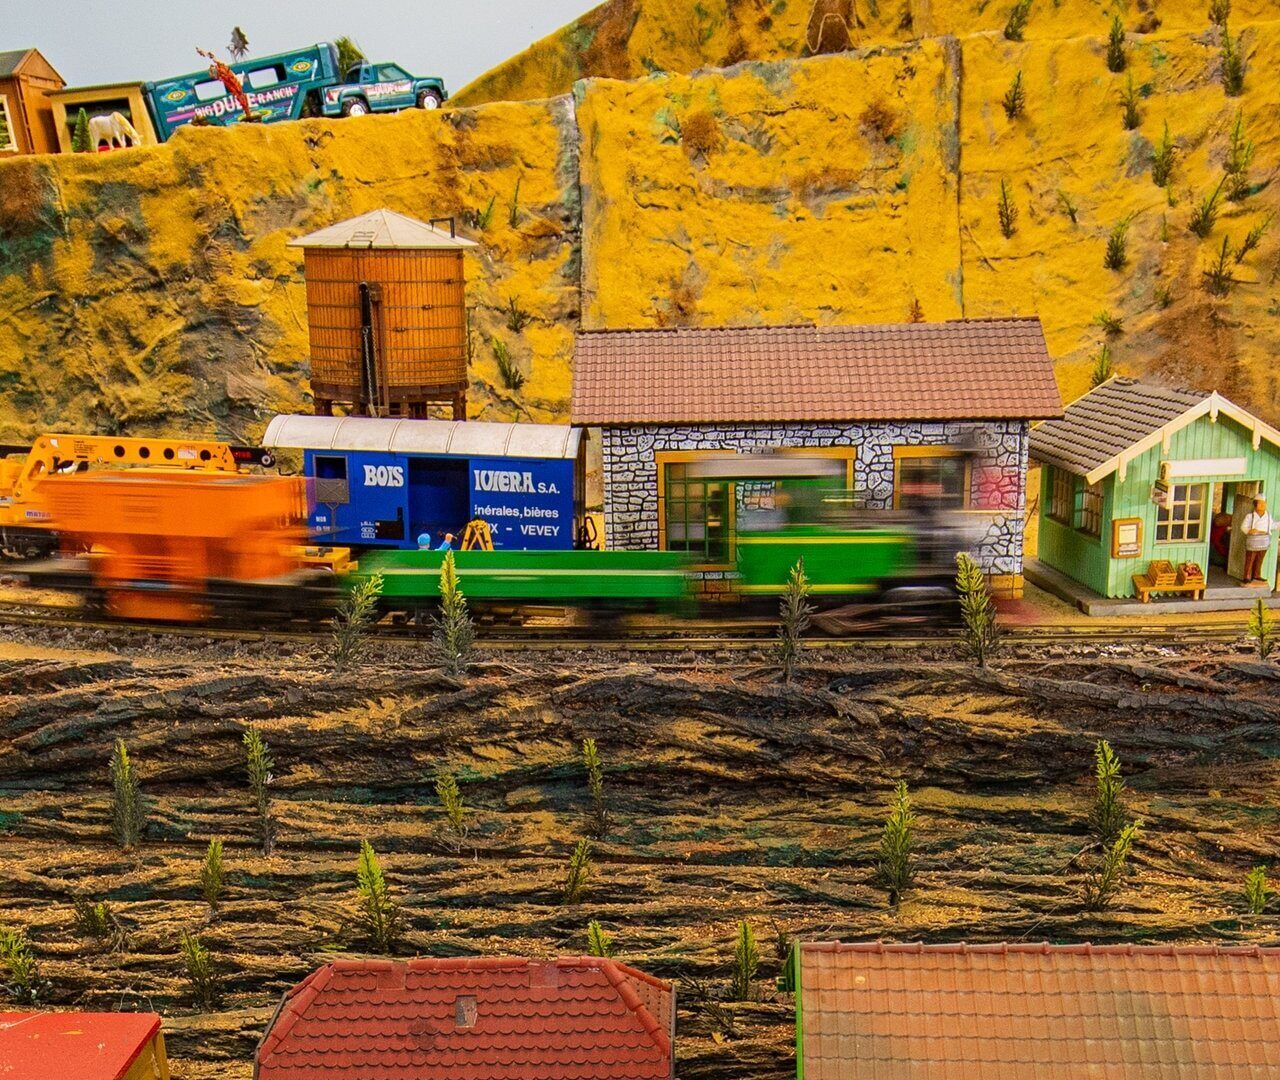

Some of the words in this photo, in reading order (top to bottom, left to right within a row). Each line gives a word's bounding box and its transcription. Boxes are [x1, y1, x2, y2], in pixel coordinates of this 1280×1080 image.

[257, 86, 294, 104] RANCH
[363, 464, 404, 487] BOIS
[537, 482, 560, 494] S.A.
[523, 506, 559, 518] bières
[520, 525, 560, 536] VEVEY
